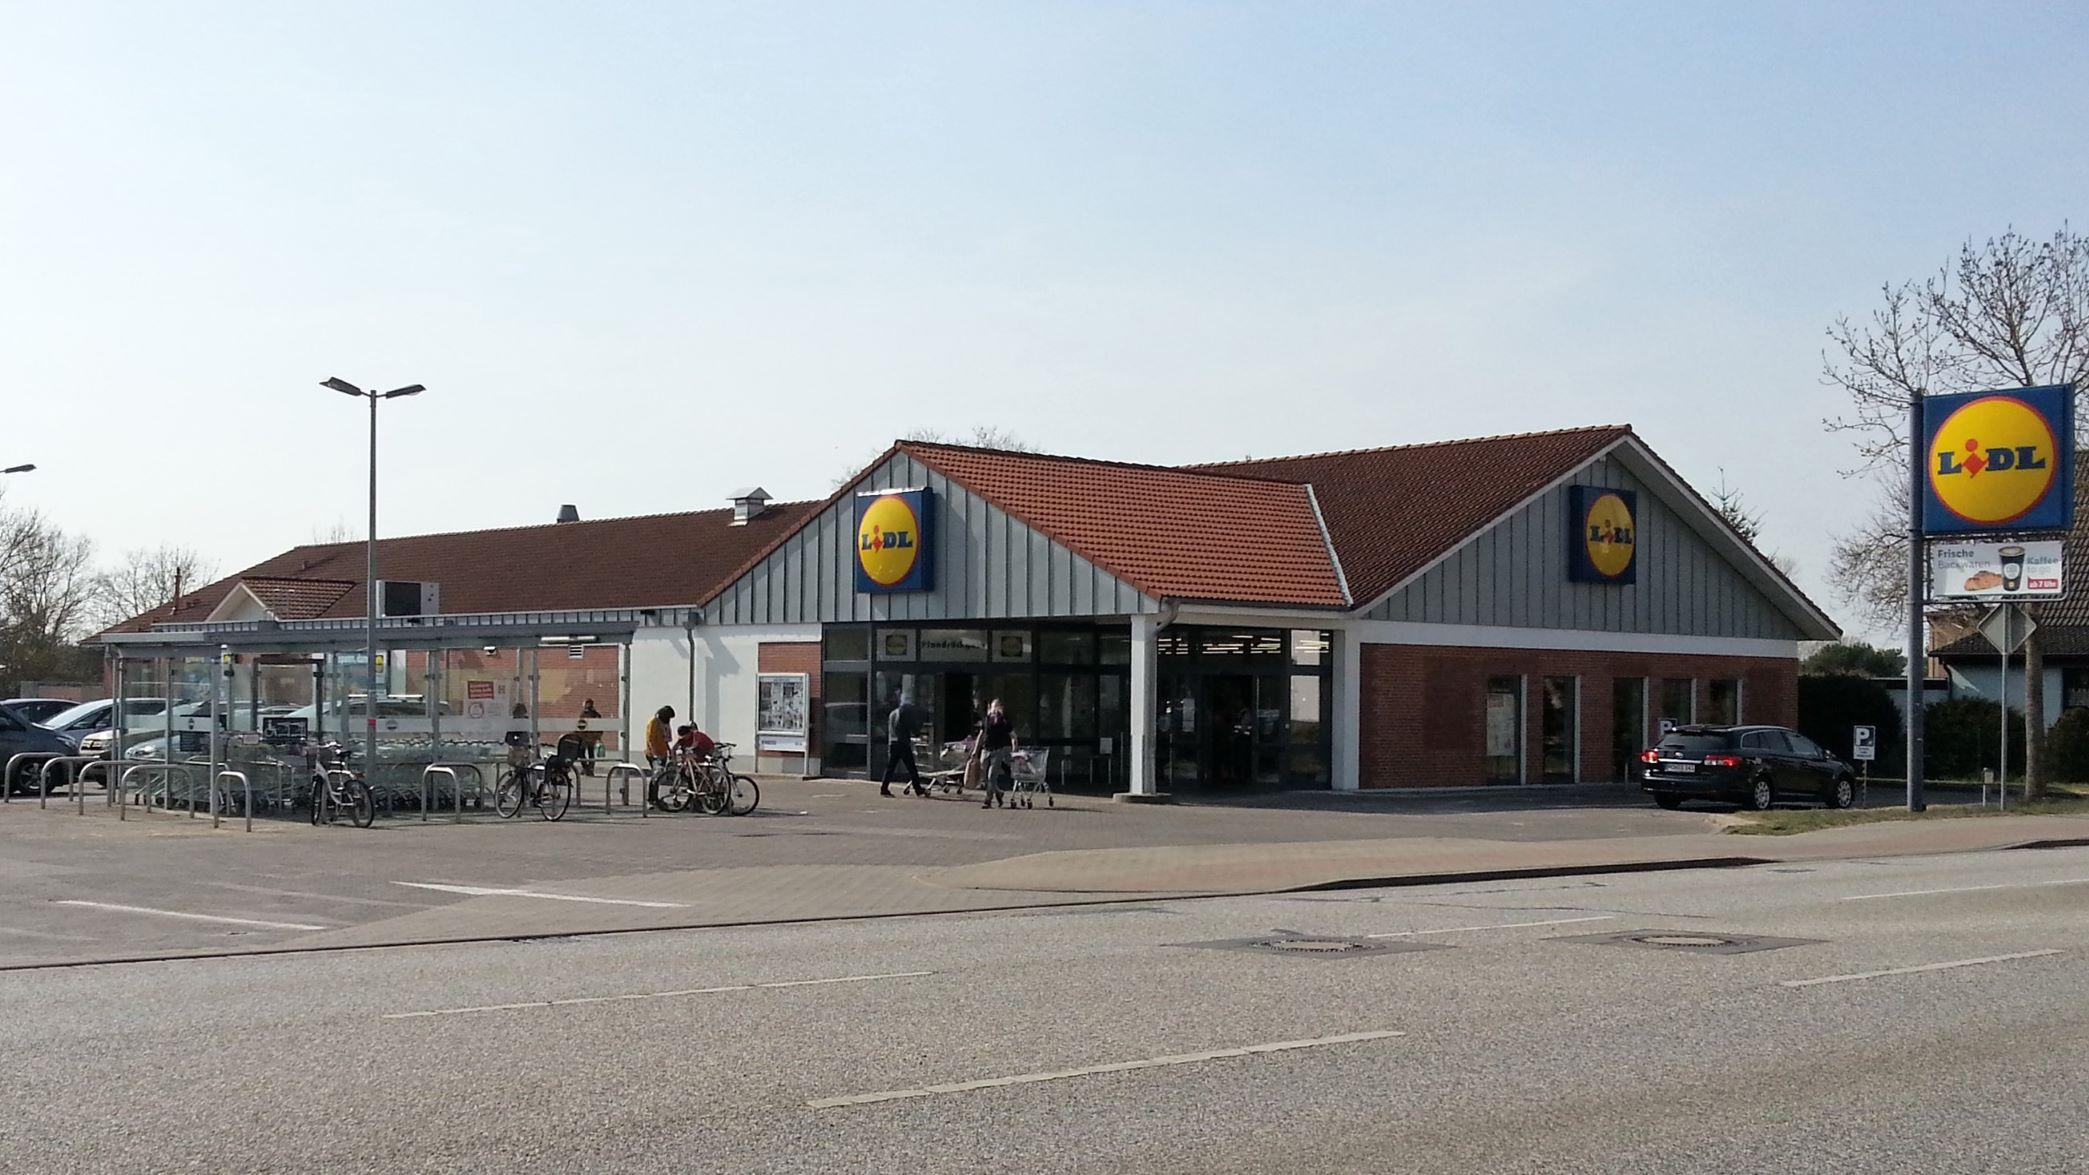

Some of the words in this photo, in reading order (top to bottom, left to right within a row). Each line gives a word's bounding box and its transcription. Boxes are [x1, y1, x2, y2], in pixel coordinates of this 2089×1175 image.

[1938, 549, 1975, 558] Frische
[2027, 556, 2059, 565] Kaffee
[1659, 720, 1673, 735] P
[1855, 728, 1870, 745] P
